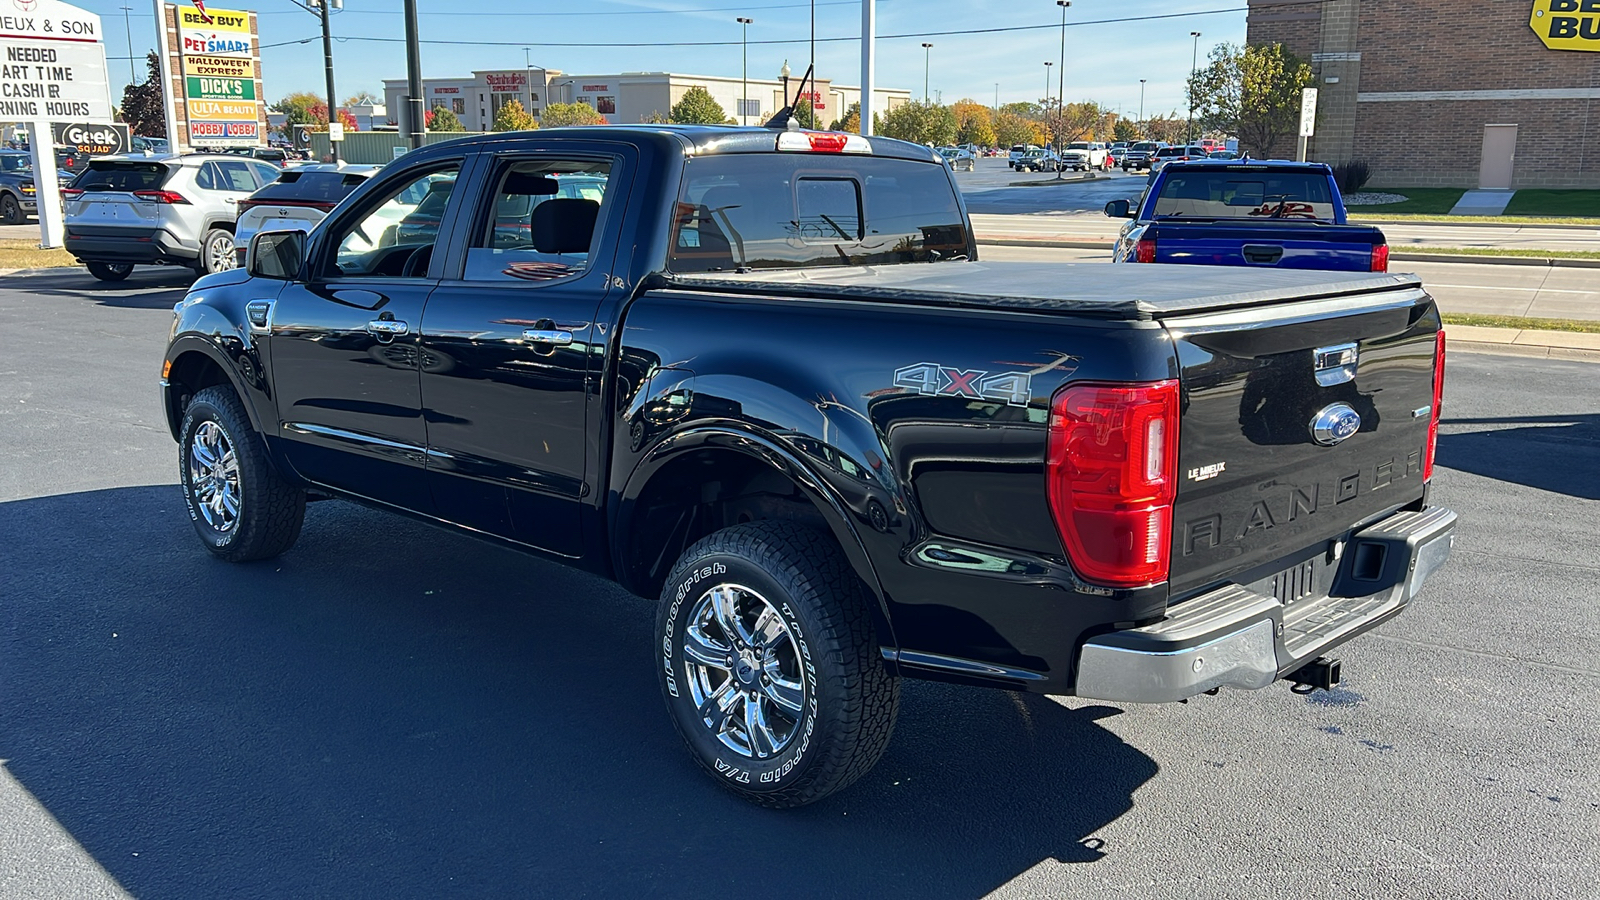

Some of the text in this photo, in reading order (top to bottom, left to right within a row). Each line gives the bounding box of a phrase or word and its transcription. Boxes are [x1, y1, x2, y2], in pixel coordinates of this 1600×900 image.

[43, 18, 53, 32] &
[61, 20, 94, 34] SON
[217, 16, 244, 27] BUY
[1548, 16, 1600, 40] BU
[7, 46, 57, 63] NEEDED
[188, 57, 250, 67] HALLOWEEN
[36, 66, 73, 81] TIME
[197, 67, 244, 75] EXPRESS
[486, 73, 526, 84] Steinhafels
[2, 83, 60, 98] CASHIER
[200, 78, 243, 95] DICK'S
[46, 102, 90, 117] HOURS
[192, 102, 255, 115] ULTA BEAUTY
[69, 127, 117, 146] Geek
[191, 123, 257, 136] HOBBY LOBBY
[1188, 461, 1226, 480] LE MIEUX
[1182, 447, 1424, 557] RANGER
[663, 562, 727, 698] BFGoodrich
[714, 757, 751, 784] T/A
